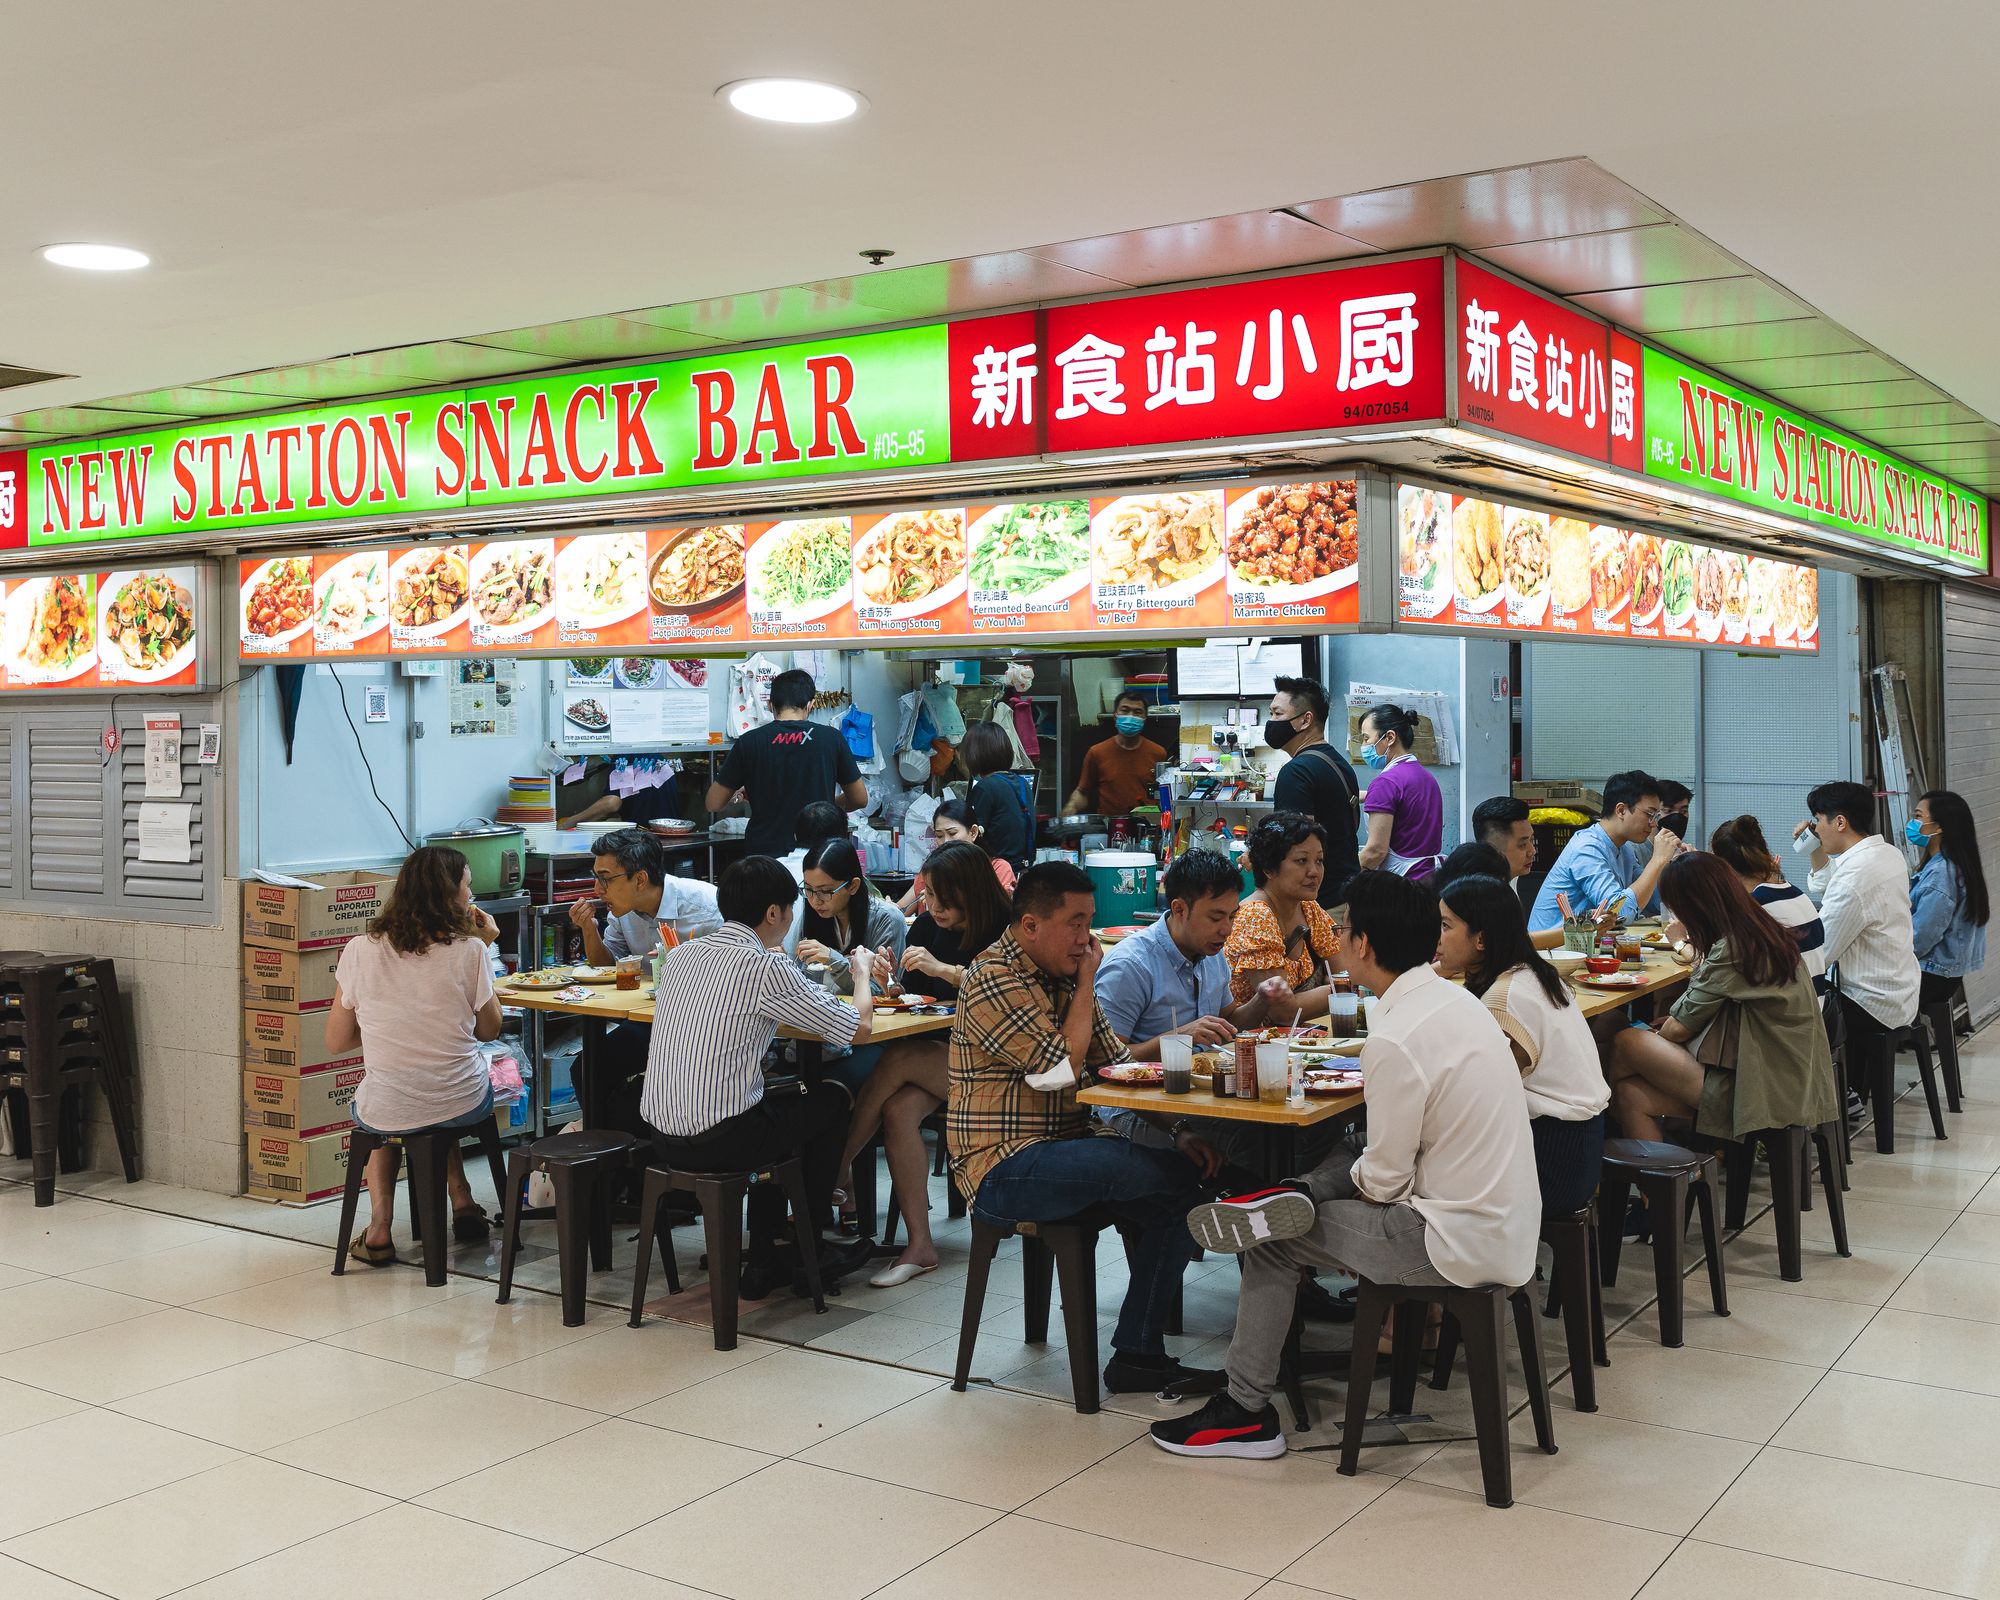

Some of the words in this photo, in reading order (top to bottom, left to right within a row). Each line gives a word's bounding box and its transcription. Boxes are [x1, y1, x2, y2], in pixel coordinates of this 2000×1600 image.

[970, 291, 1419, 429] 新食站小厨
[1464, 297, 1635, 442] 新食站小厨
[1343, 401, 1410, 420] 94/07054
[1466, 404, 1495, 424] 94/07054
[41, 445, 154, 535] NEW
[172, 411, 412, 522] STATION
[435, 378, 665, 498] SNACK
[691, 353, 869, 471] BAR
[1677, 376, 1764, 492] NEW
[1772, 415, 1879, 528] STATION
[1882, 463, 1945, 547] SNACK
[1947, 490, 1981, 559] BAR
[973, 603, 1022, 614] Fermented
[1025, 602, 1069, 612] Beancurd
[1098, 599, 1115, 610] Stir
[1118, 599, 1133, 611] Fry
[1136, 597, 1195, 609] Bittergourd
[1234, 606, 1279, 617] Marmite
[1282, 605, 1325, 616] Chicken
[859, 621, 878, 630] Kum
[881, 620, 907, 630] Hiong
[909, 619, 940, 630] Sotong
[988, 617, 1005, 627] You
[1007, 616, 1024, 627] Mai
[1114, 613, 1136, 623] Beef
[653, 629, 685, 640] Hotplate
[687, 628, 712, 638] Pepper
[714, 626, 732, 635] Beef
[752, 624, 765, 633] Stir
[767, 624, 779, 635] Fry
[782, 624, 796, 633] Pea
[798, 622, 826, 632] Shoots
[259, 888, 284, 901] MARIGOLD
[338, 887, 374, 901] MARIGOLD
[256, 900, 285, 911] EVAPORATED
[260, 908, 282, 916] CREAMER
[328, 900, 382, 912] EVAPORATED
[335, 910, 375, 920] CREAMER
[337, 1071, 366, 1086] MARIGO
[328, 1086, 358, 1099] EVAPO
